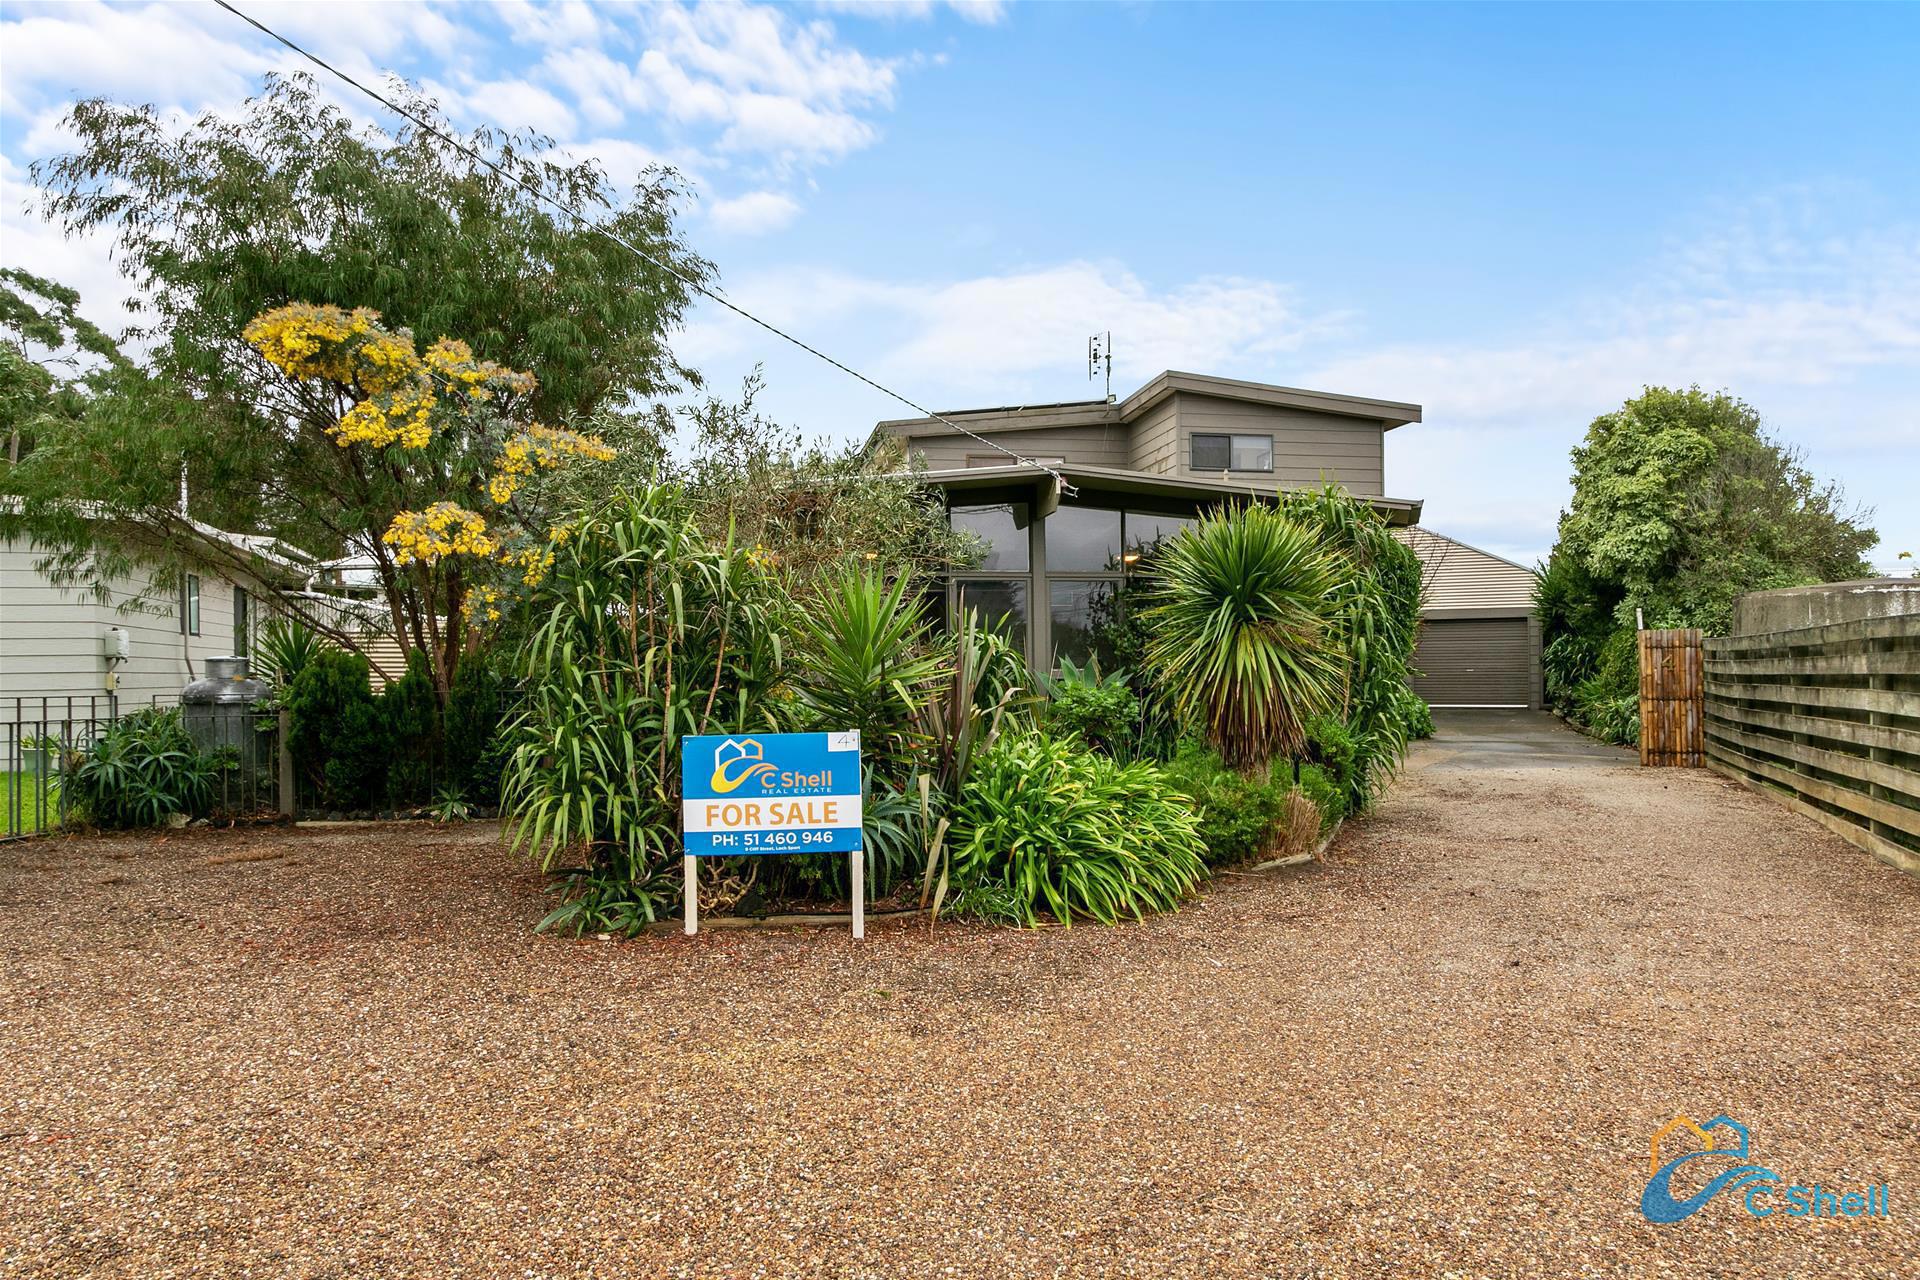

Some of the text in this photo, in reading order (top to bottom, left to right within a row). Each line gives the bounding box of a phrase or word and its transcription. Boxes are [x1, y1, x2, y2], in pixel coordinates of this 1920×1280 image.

[761, 770, 832, 788] C Shell
[706, 802, 838, 827] FOR SALE
[712, 831, 833, 846] PH: 51 460 946
